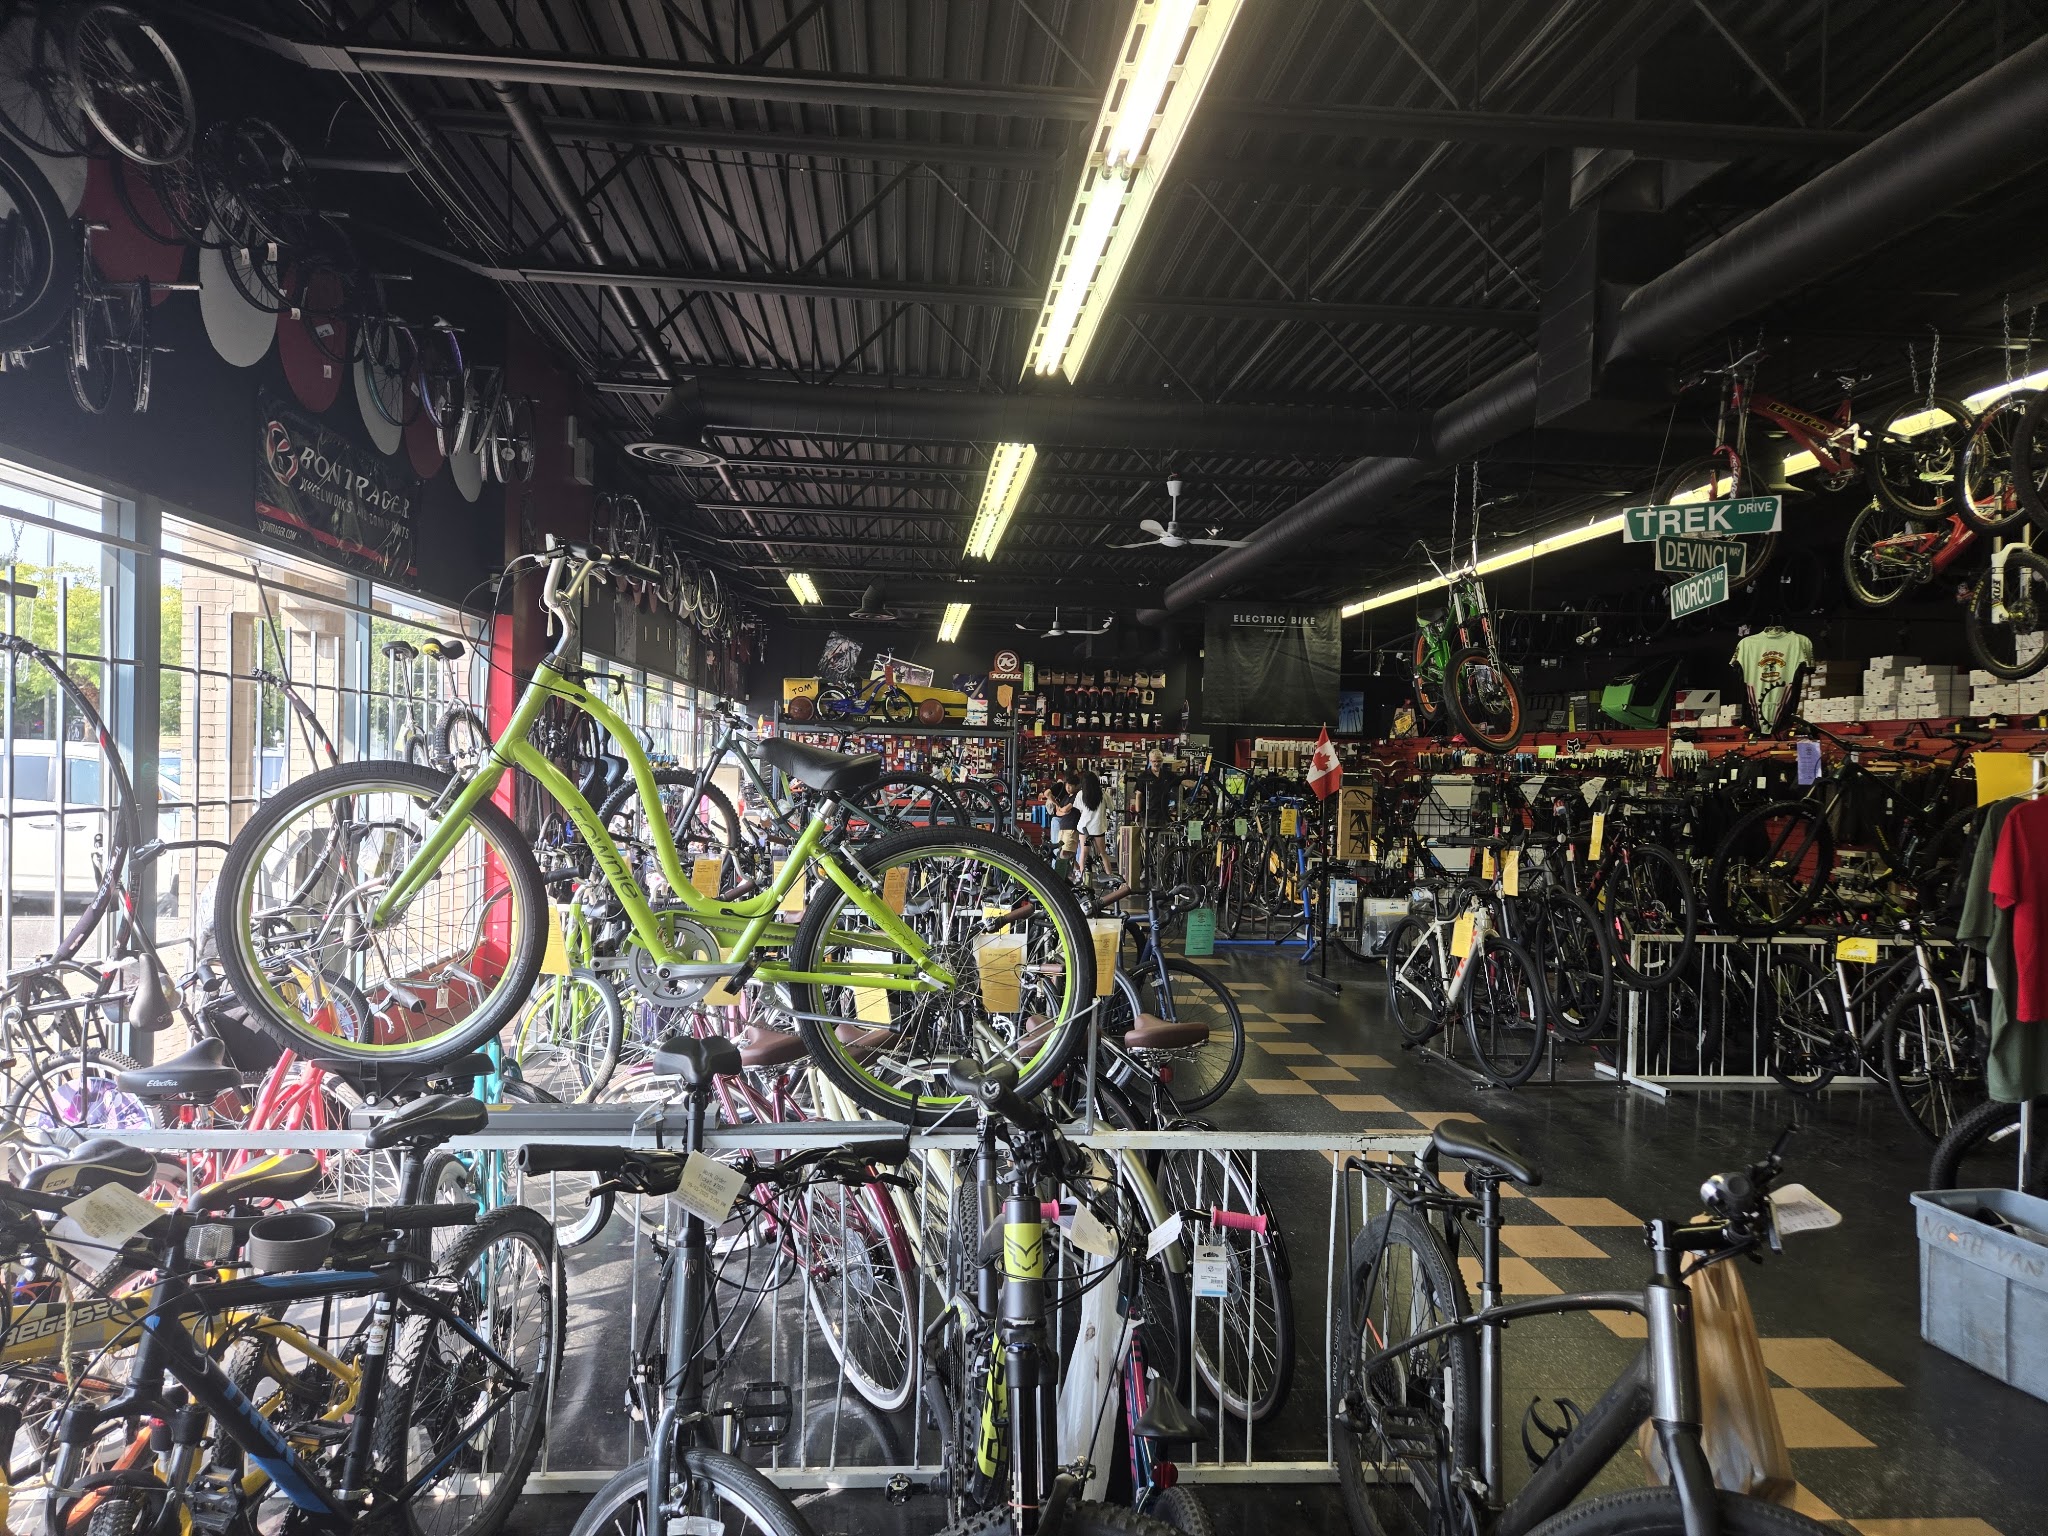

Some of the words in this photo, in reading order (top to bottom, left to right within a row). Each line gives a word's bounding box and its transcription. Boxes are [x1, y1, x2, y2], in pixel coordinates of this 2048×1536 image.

[1769, 404, 1825, 431] Balfa
[299, 476, 353, 513] WHEELWORKS
[300, 447, 410, 518] BONTRAGER
[1635, 504, 1733, 536] TREK
[1738, 501, 1773, 514] DRIVE
[1665, 541, 1727, 569] DEVINCI
[1676, 576, 1712, 613] NORCO
[1712, 570, 1724, 584] PLACE
[1233, 614, 1286, 624] ELECTRIC
[1291, 616, 1316, 625] BIKE
[930, 784, 958, 809] MAXXIS
[568, 804, 639, 900] townie
[865, 909, 913, 946] electra
[1839, 953, 1873, 962] CLEARANCE
[146, 1078, 179, 1088] Electra
[45, 1178, 68, 1189] CCM
